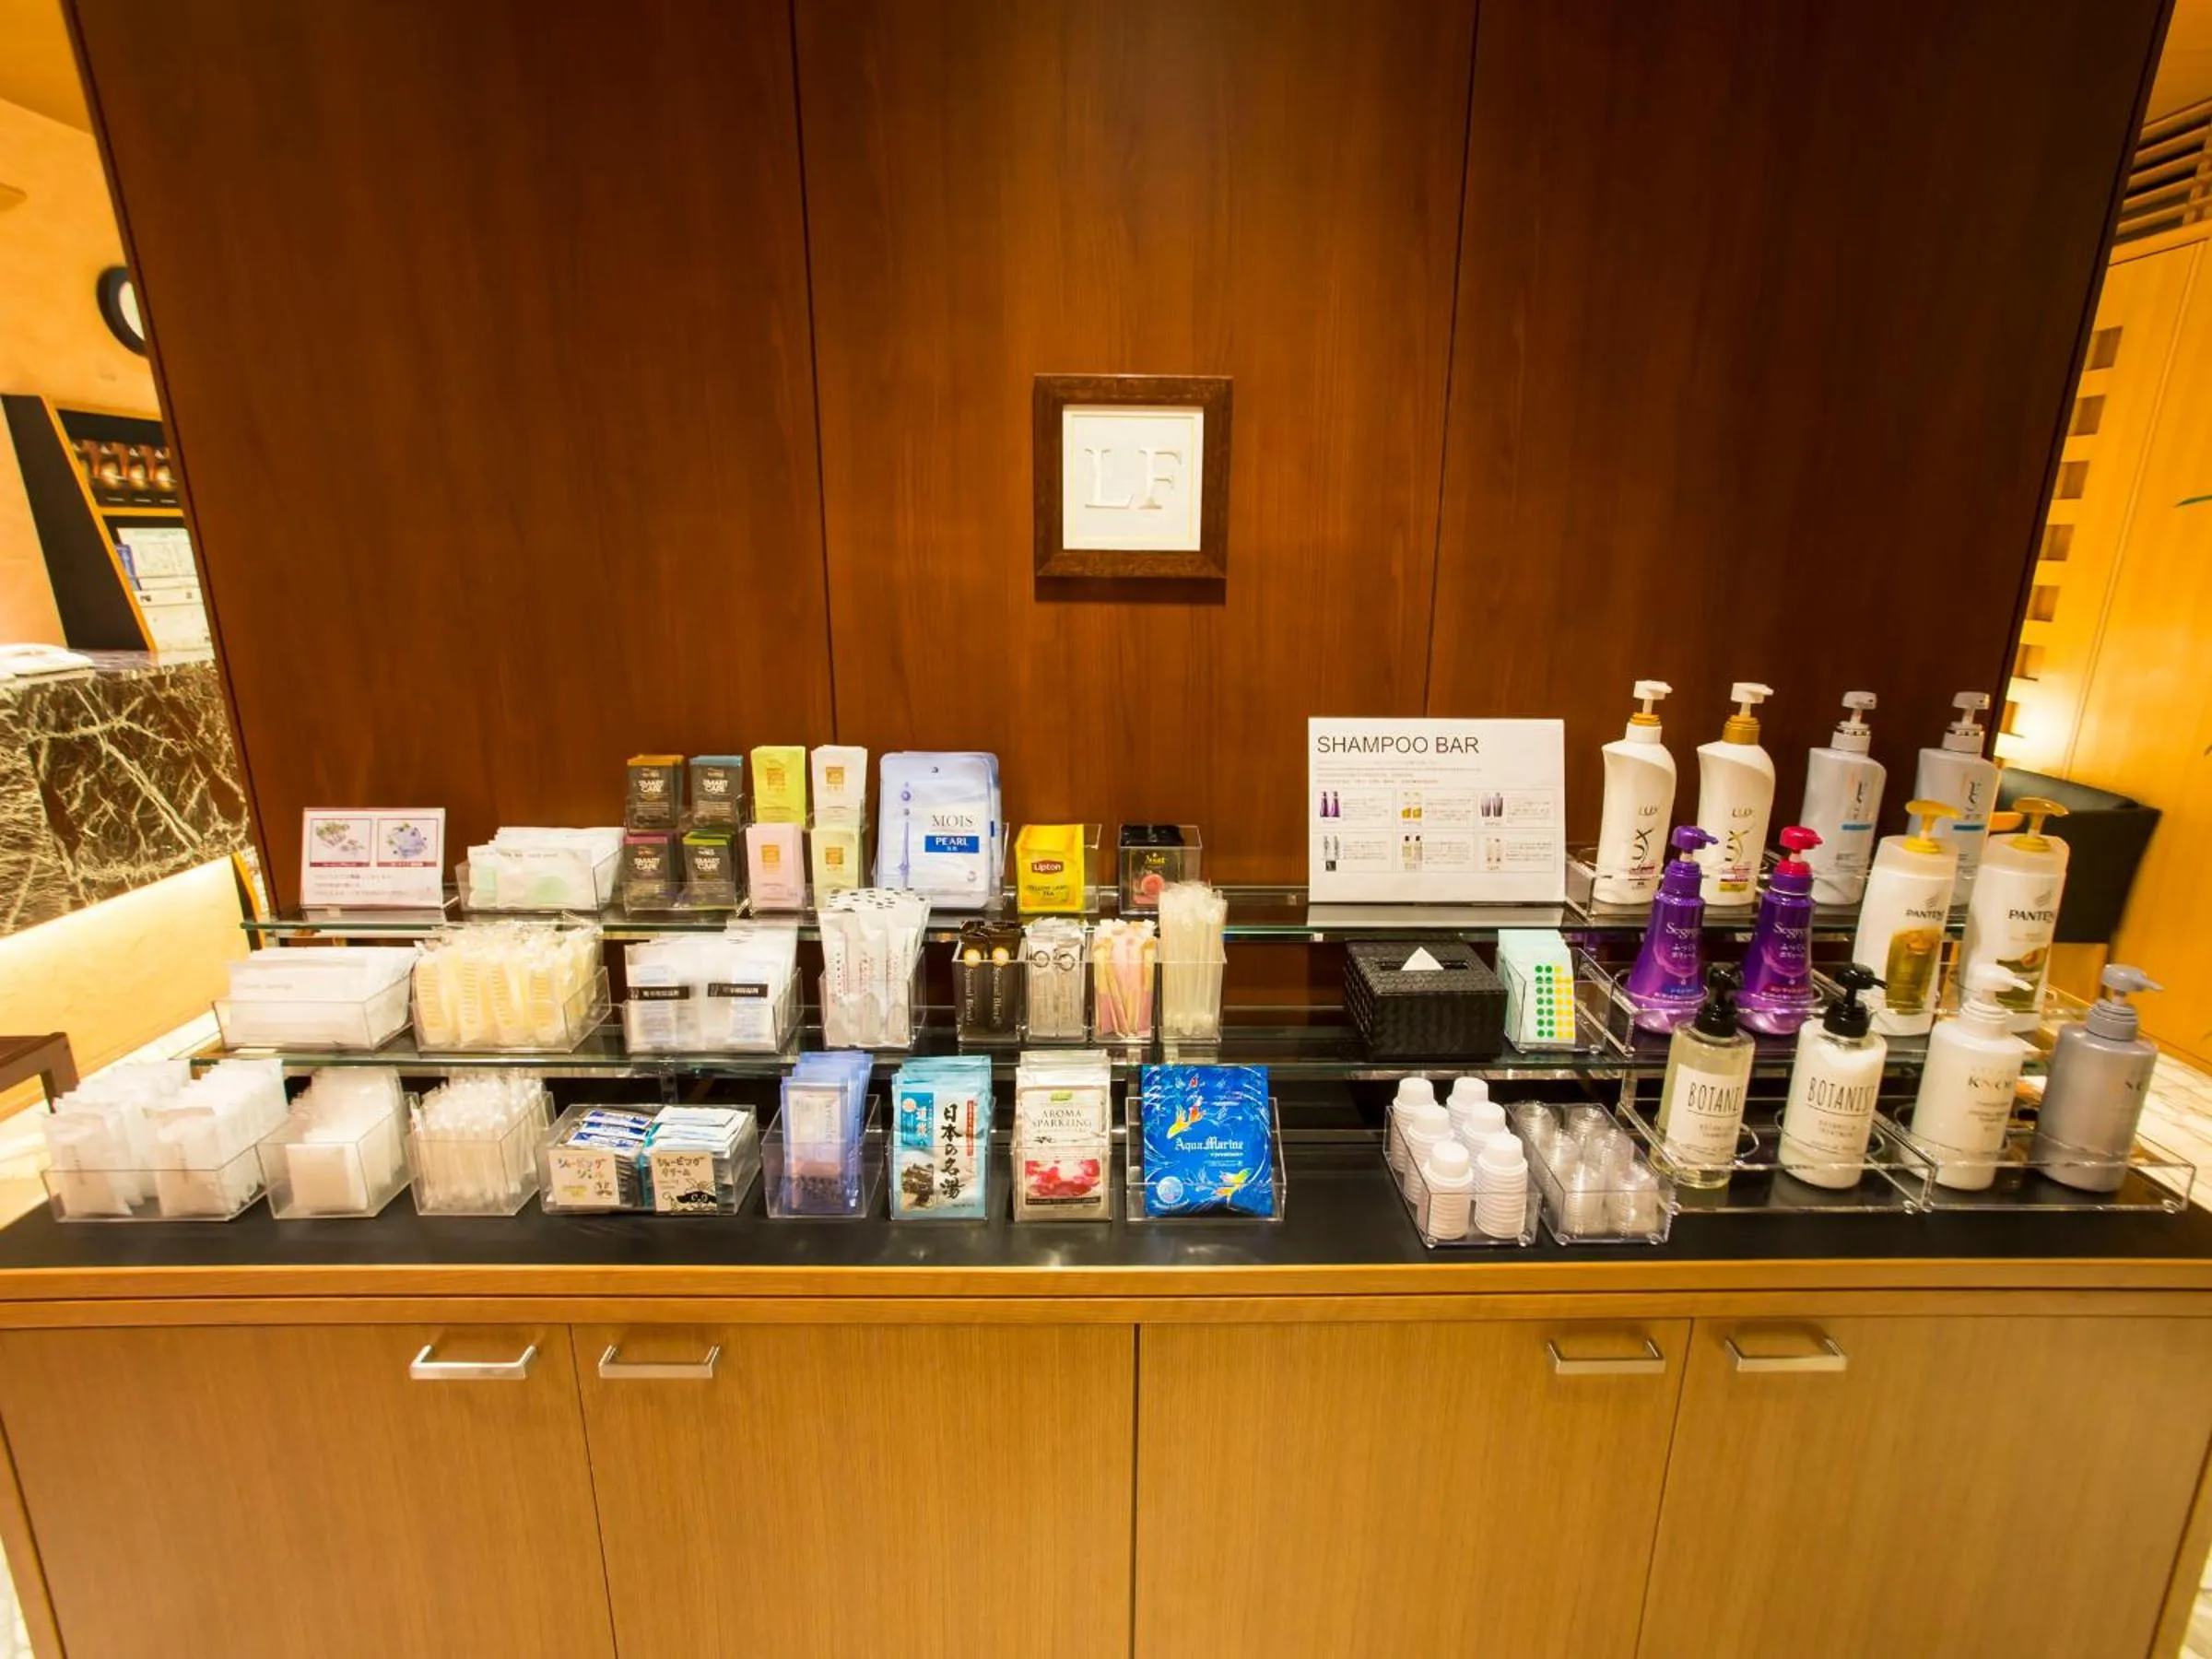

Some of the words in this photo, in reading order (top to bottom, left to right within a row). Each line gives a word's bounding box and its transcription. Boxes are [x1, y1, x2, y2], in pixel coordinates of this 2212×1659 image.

[1084, 448, 1183, 511] LF
[1316, 736, 1429, 754] SHAMPOO
[1435, 736, 1480, 754] BAR
[932, 814, 974, 828] MOIS
[935, 837, 968, 846] PEARL
[1033, 862, 1062, 873] Lipton
[1688, 1082, 1741, 1113] BOTANI
[1042, 1109, 1083, 1118] AROMA
[939, 1103, 965, 1200] 日本の名湯
[1174, 1136, 1203, 1152] Aqua
[1203, 1135, 1244, 1151] Marine
